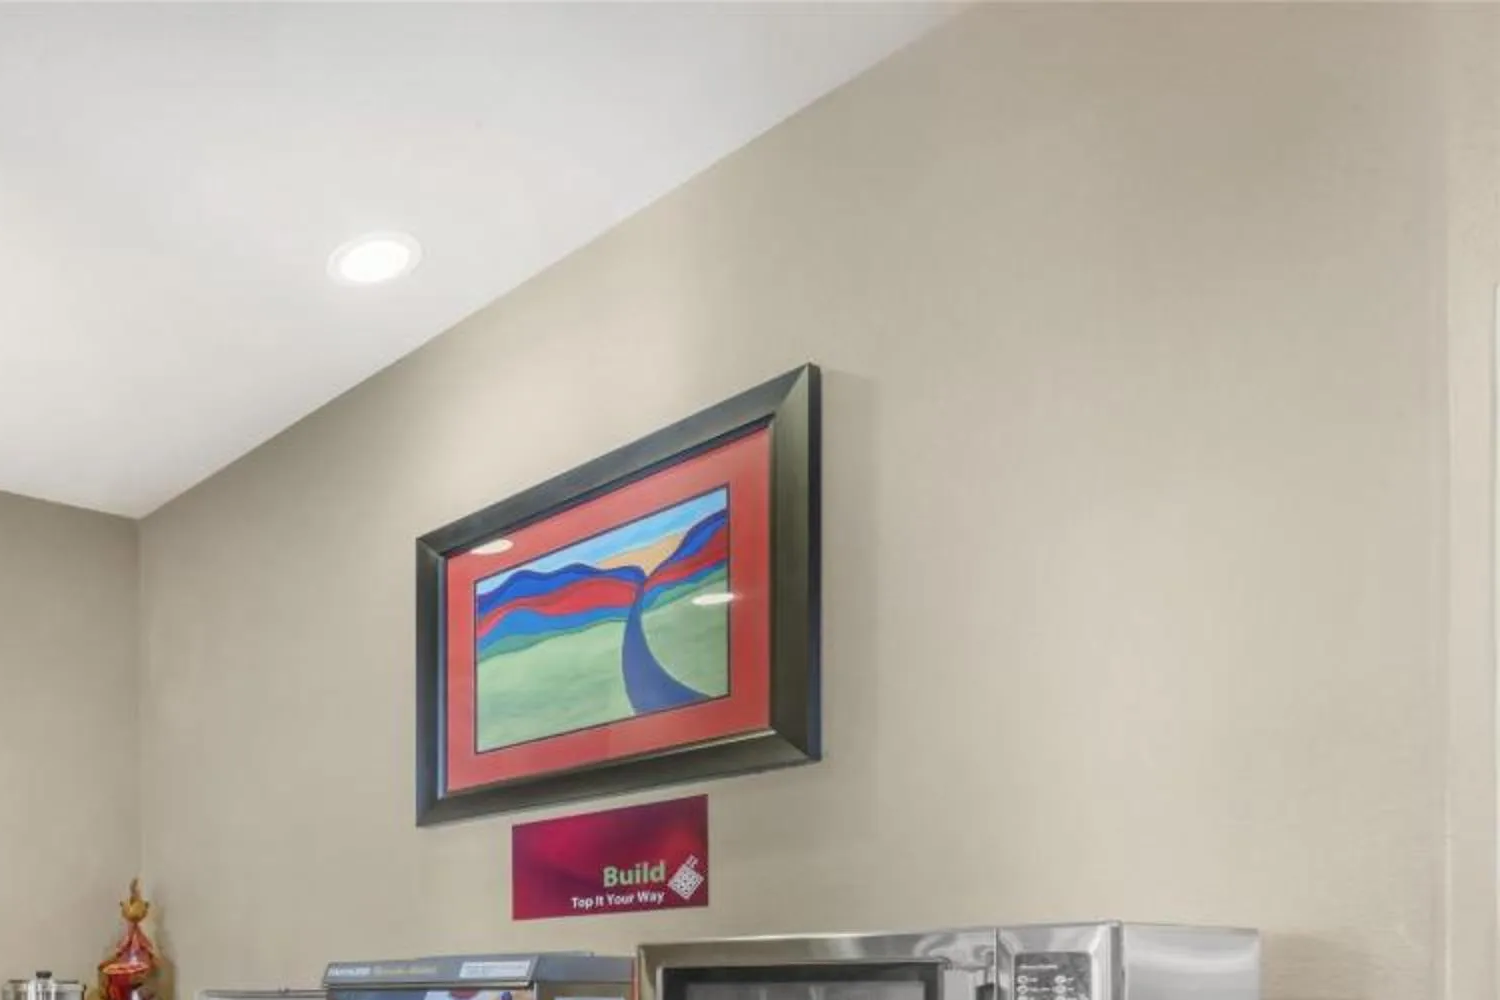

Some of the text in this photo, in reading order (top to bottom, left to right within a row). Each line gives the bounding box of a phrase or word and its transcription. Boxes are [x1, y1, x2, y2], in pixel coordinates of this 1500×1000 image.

[603, 859, 666, 888] Build
[571, 891, 664, 910] Top It Your Way
